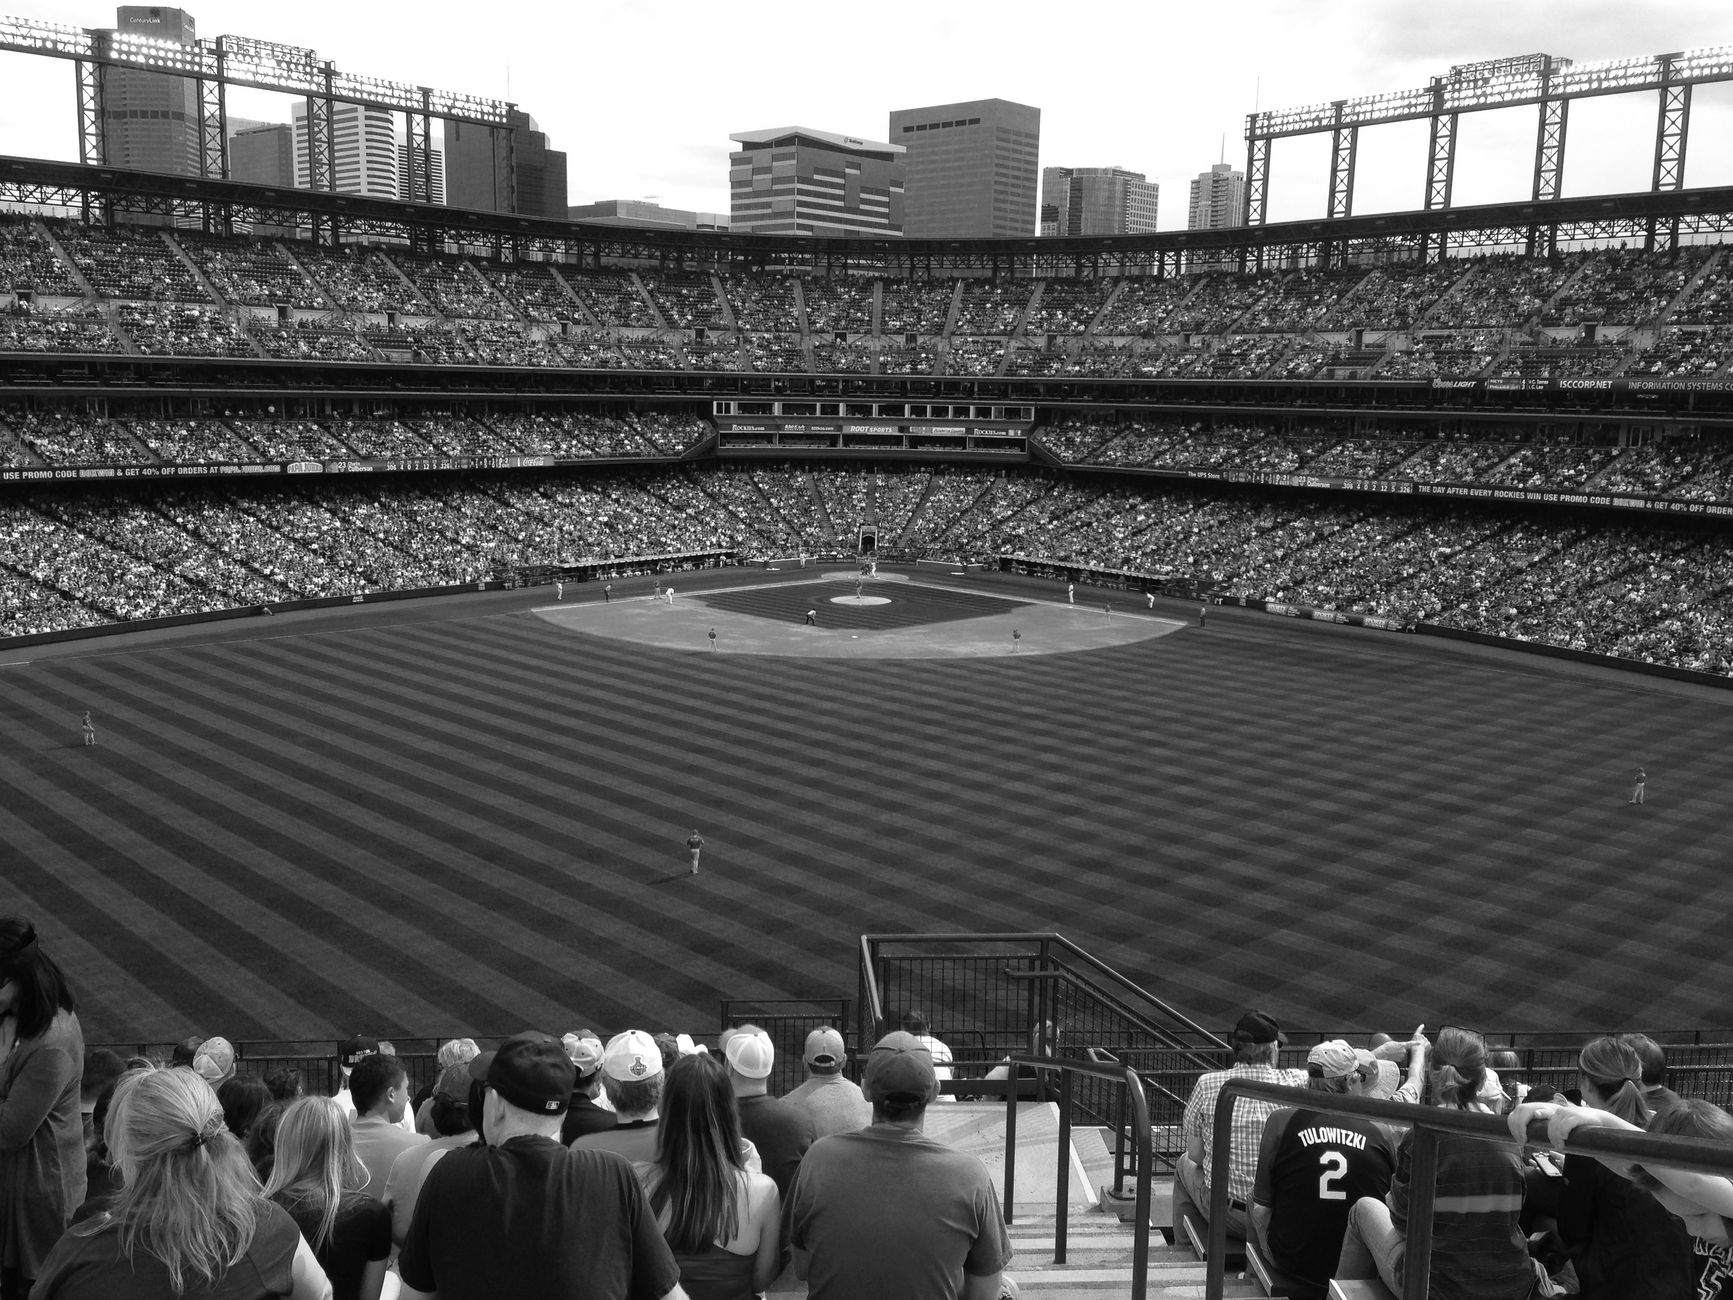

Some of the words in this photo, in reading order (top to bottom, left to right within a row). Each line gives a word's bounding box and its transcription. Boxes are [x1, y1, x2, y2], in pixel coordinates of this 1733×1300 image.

[1559, 380, 1613, 389] ISCCORP.NET
[1628, 381, 1686, 390] INFORMATION
[1687, 382, 1723, 390] SYSTEMS
[22, 471, 53, 479] PROMO
[55, 470, 77, 478] CODE
[116, 468, 123, 476] &
[142, 467, 160, 476] 40%
[161, 467, 176, 475] OFF
[178, 466, 208, 474] ORDERS
[209, 466, 218, 474] AT
[1447, 487, 1468, 495] AFTER
[1470, 488, 1492, 497] EVERY
[1494, 490, 1525, 499] ROCKIES
[1527, 492, 1541, 500] WIN
[1543, 494, 1558, 502] USE
[1560, 494, 1588, 503] PROMO
[1590, 496, 1611, 504] CODE
[1670, 503, 1687, 511] 40%
[1689, 504, 1704, 512] OFF
[1298, 1126, 1367, 1150] TULOWITZKI
[1320, 1151, 1347, 1199] 2
